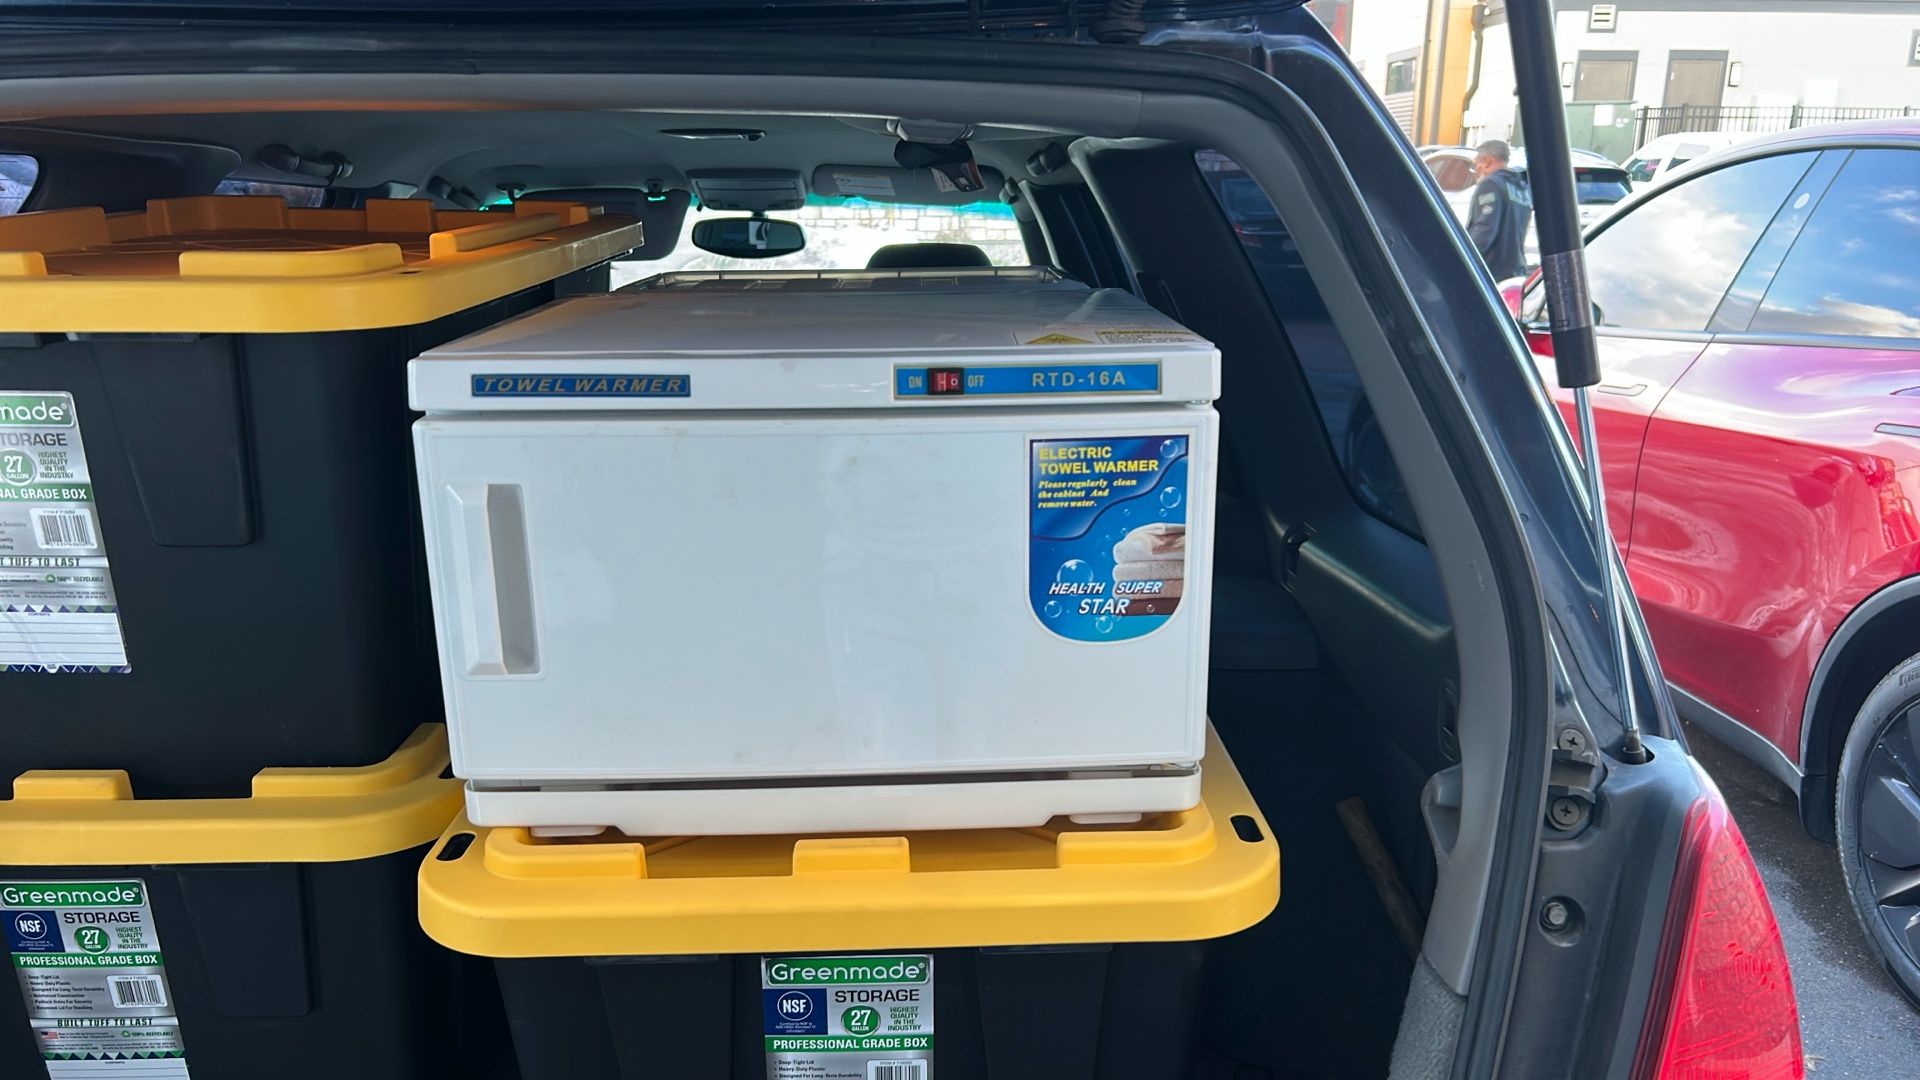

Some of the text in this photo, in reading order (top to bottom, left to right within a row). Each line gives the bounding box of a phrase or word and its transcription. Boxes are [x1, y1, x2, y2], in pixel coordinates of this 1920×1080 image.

[482, 378, 682, 392] TOWEL WARMER
[908, 375, 985, 389] ON OFF
[1032, 371, 1126, 387] RTD-16A
[1038, 446, 1112, 460] ELECTRIC
[4, 455, 23, 473] 27
[1039, 460, 1159, 475] TOWEL WARMER
[1038, 478, 1137, 489] Please regularly clean
[20, 488, 60, 499] GRADE
[62, 488, 87, 499] BOX
[1038, 488, 1109, 498] the cabinet And
[1070, 499, 1097, 508] water.
[10, 557, 33, 567] TUFF
[38, 557, 50, 567] TO
[55, 557, 81, 567] LAST
[1048, 581, 1163, 595] HEALTH SUPER
[1078, 598, 1130, 615] STAR
[3, 886, 135, 904] Greenmade
[64, 911, 141, 924] STORAGE
[18, 920, 41, 933] NSF
[81, 930, 100, 945] 27
[20, 954, 158, 966] PROFESSIONAL GRADE BOX
[771, 961, 920, 981] Greenmade
[834, 988, 920, 1003] STORAGE
[782, 999, 807, 1014] NSF
[57, 1018, 153, 1027] BUILT TUFF TO LAST
[850, 1009, 871, 1026] 27
[773, 1037, 928, 1050] PROFESSIONAL GRADE BOX
